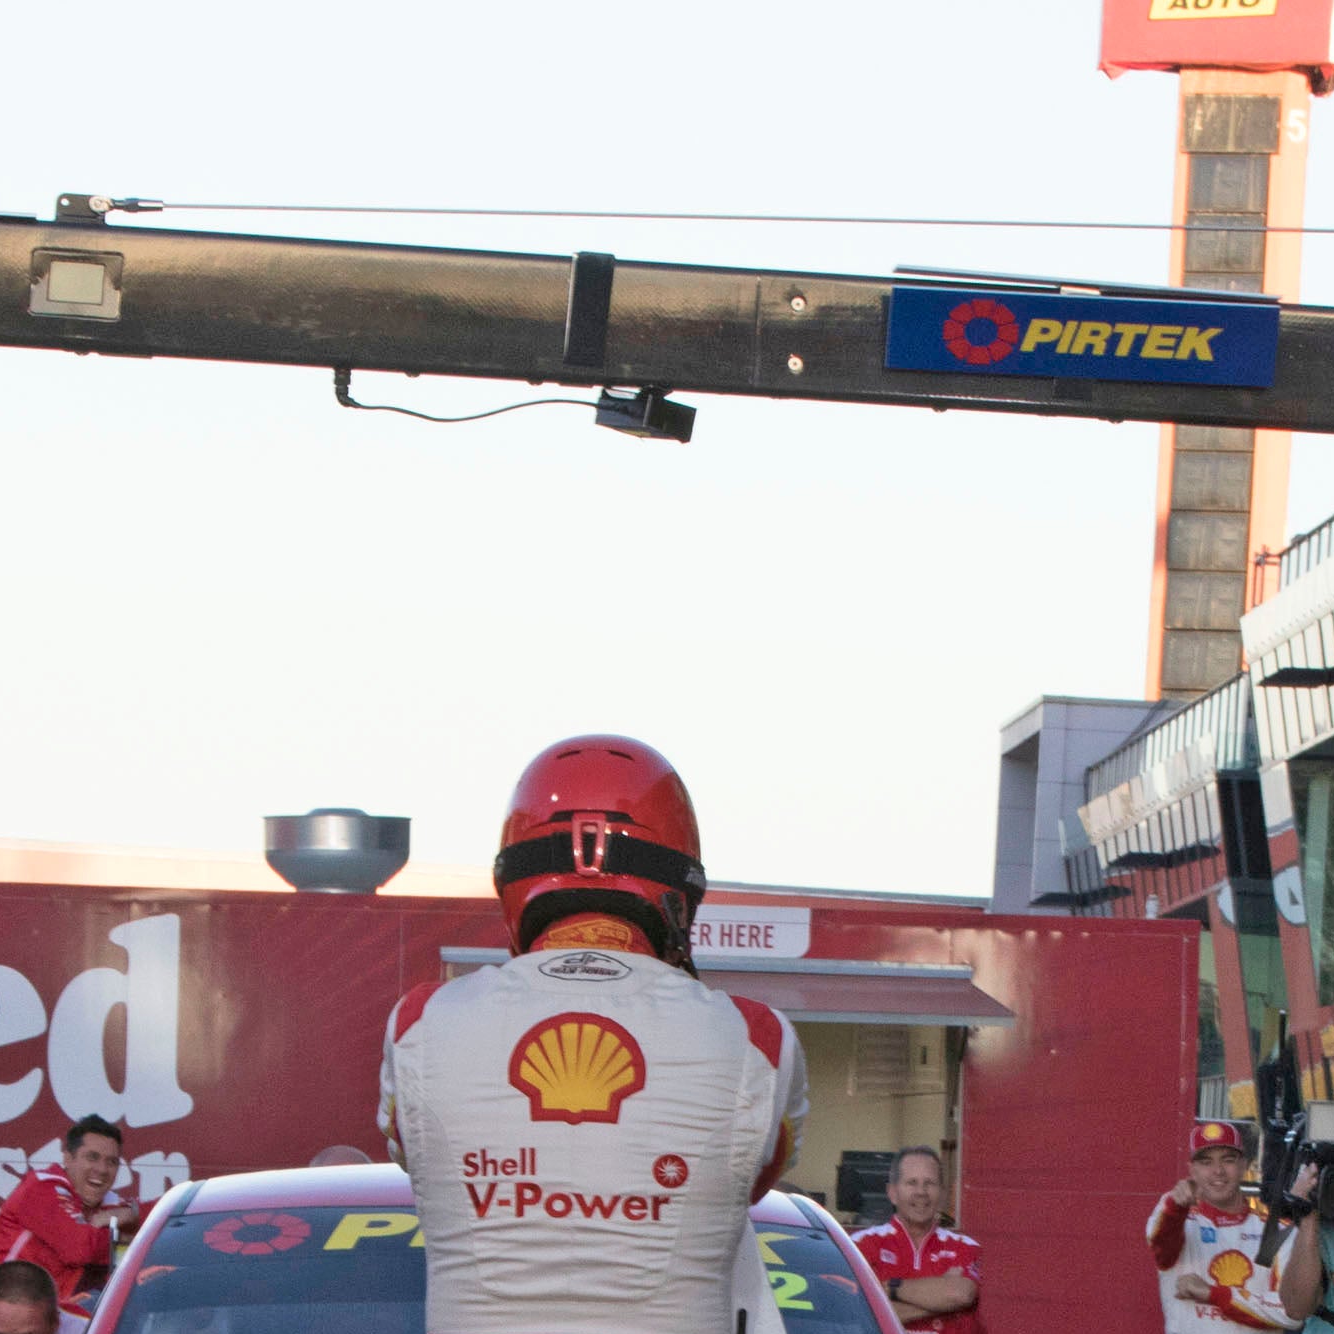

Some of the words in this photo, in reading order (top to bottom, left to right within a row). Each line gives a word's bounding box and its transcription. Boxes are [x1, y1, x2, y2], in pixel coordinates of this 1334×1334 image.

[1022, 320, 1219, 360] PIRTEK
[720, 923, 775, 949] HERE
[462, 1147, 537, 1178] Shell
[466, 1183, 671, 1222] V-Power
